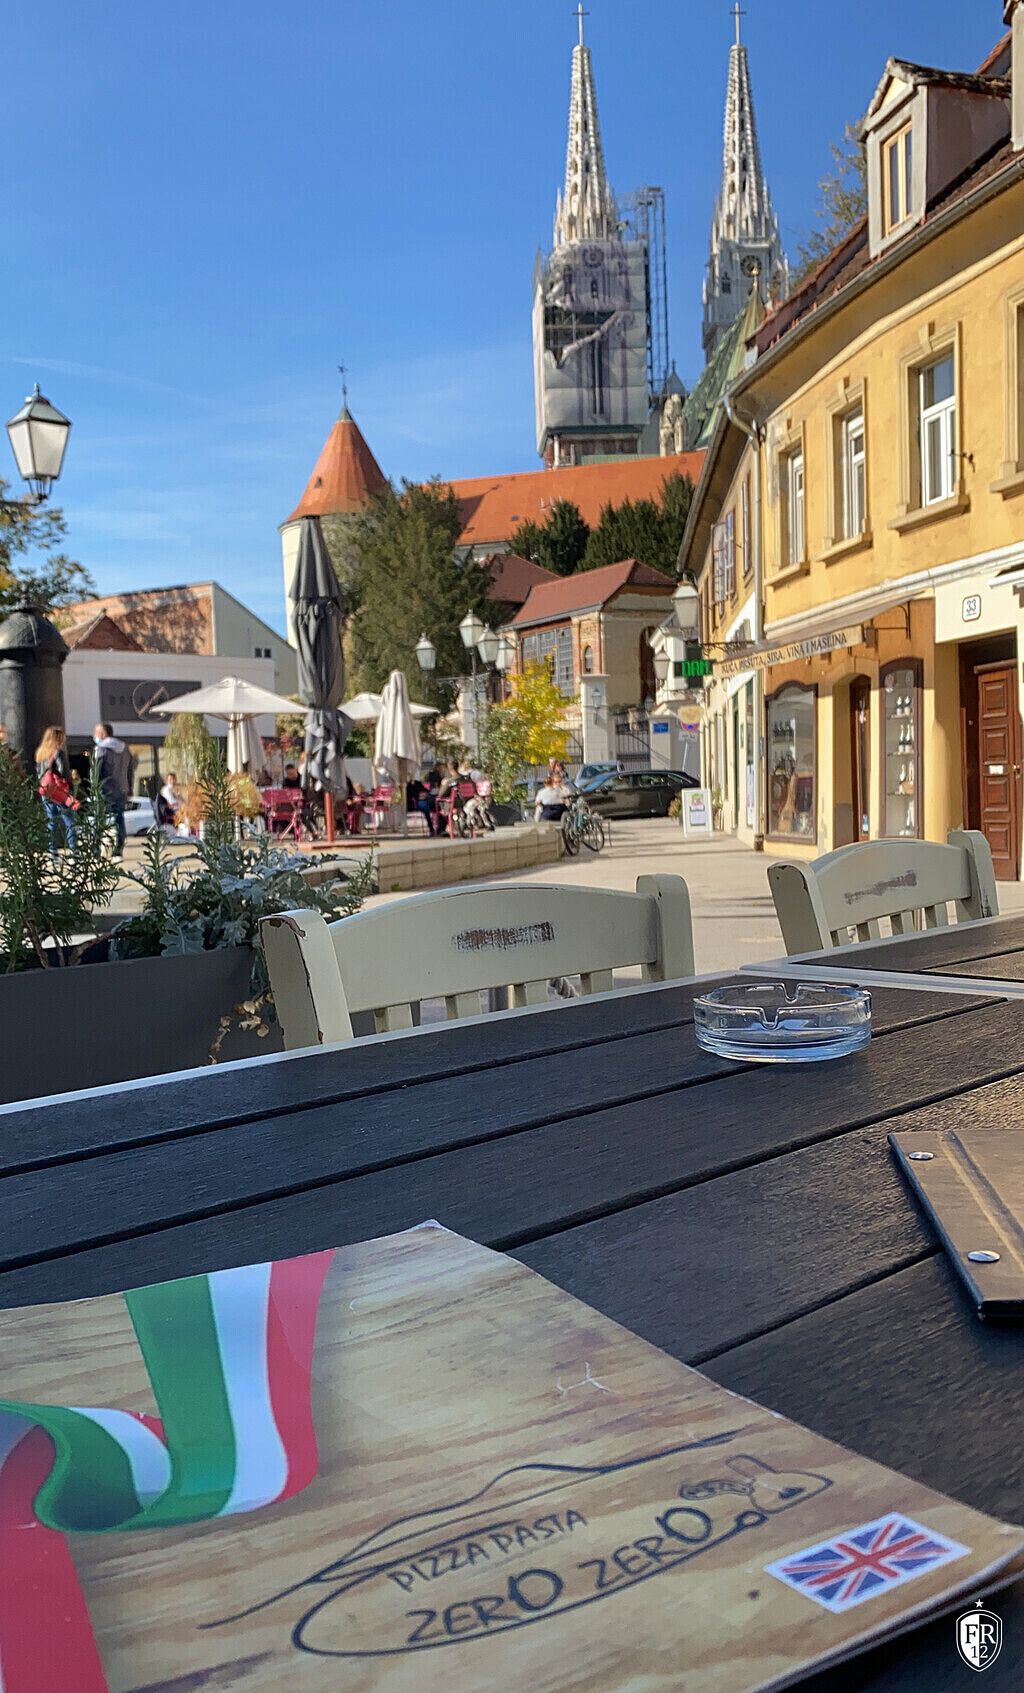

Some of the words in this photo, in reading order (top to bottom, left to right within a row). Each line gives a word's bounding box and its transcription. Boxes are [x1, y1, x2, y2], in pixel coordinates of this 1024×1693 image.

[966, 598, 977, 613] 33
[786, 643, 805, 658] VINA
[386, 1541, 490, 1593] PIZZA
[488, 1509, 588, 1553] PASTA
[405, 1568, 565, 1643] ZERO
[577, 1507, 713, 1590] ZERO
